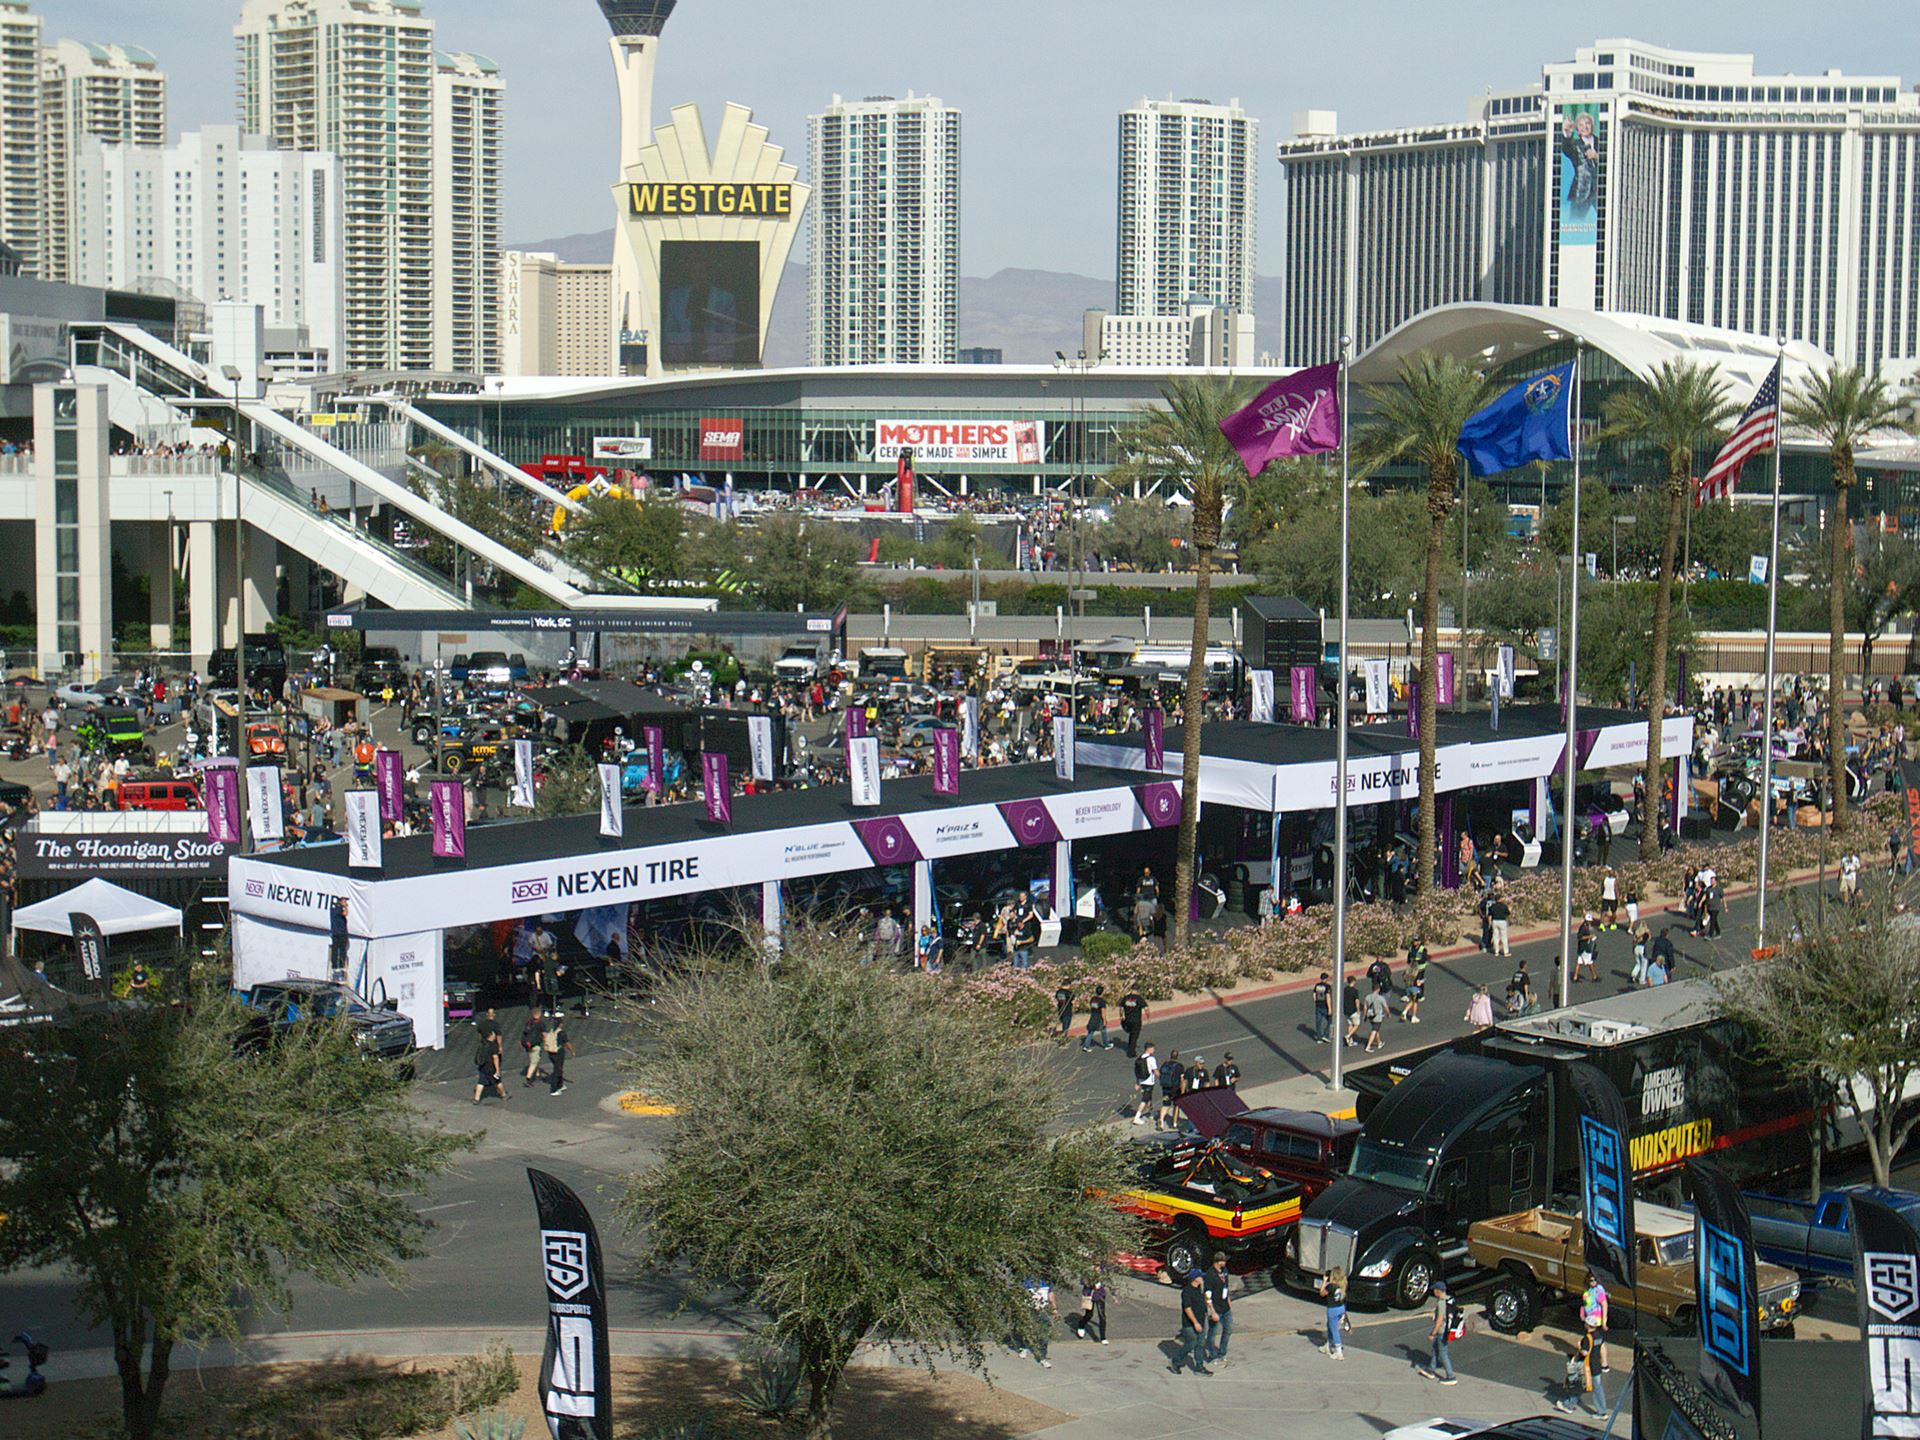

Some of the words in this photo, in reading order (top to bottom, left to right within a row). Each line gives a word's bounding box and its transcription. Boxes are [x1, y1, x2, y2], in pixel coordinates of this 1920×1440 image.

[312, 168, 321, 202] SUITES
[631, 183, 791, 214] WESTGATE
[312, 204, 321, 264] SPRINGHILL
[508, 252, 519, 336] SAHARA
[703, 431, 741, 442] SEMA
[879, 424, 1009, 445] MOTHERS
[879, 447, 924, 458] CERIC
[926, 447, 954, 458] MADE
[972, 447, 1008, 459] SIMPLE
[533, 617, 557, 629] York,
[557, 617, 572, 628] SC
[634, 620, 666, 628] ALUMINUM
[668, 620, 693, 629] WHEELS
[472, 745, 497, 754] KMC
[861, 755, 869, 783] NEXEN
[1361, 768, 1410, 791] NEXEN
[1413, 762, 1441, 784] TE
[385, 770, 393, 798] NEXEN
[713, 770, 721, 798] NEXEN
[260, 785, 269, 815] NEXEN
[1075, 806, 1091, 816] NEXEN
[1091, 802, 1121, 814] TECHNOLOGY
[219, 819, 228, 840] TIRE
[263, 815, 271, 835] TIRE
[359, 811, 368, 841] NEXEN
[35, 839, 72, 858] The
[75, 839, 172, 861] Hoonigan
[174, 838, 225, 861] Store
[361, 842, 369, 862] TIRE
[444, 832, 454, 853] TIRE
[511, 881, 548, 900] NEXEN
[557, 865, 638, 897] NEXEN
[645, 856, 699, 884] TIRE
[267, 883, 313, 907] NEXEN
[79, 940, 94, 980] LIBERTY
[88, 940, 102, 979] FORGED
[391, 963, 410, 971] NEXEN
[1642, 1063, 1686, 1091] AMERICAN
[1641, 1081, 1685, 1116] OWNED
[1708, 1233, 1740, 1360] DTS
